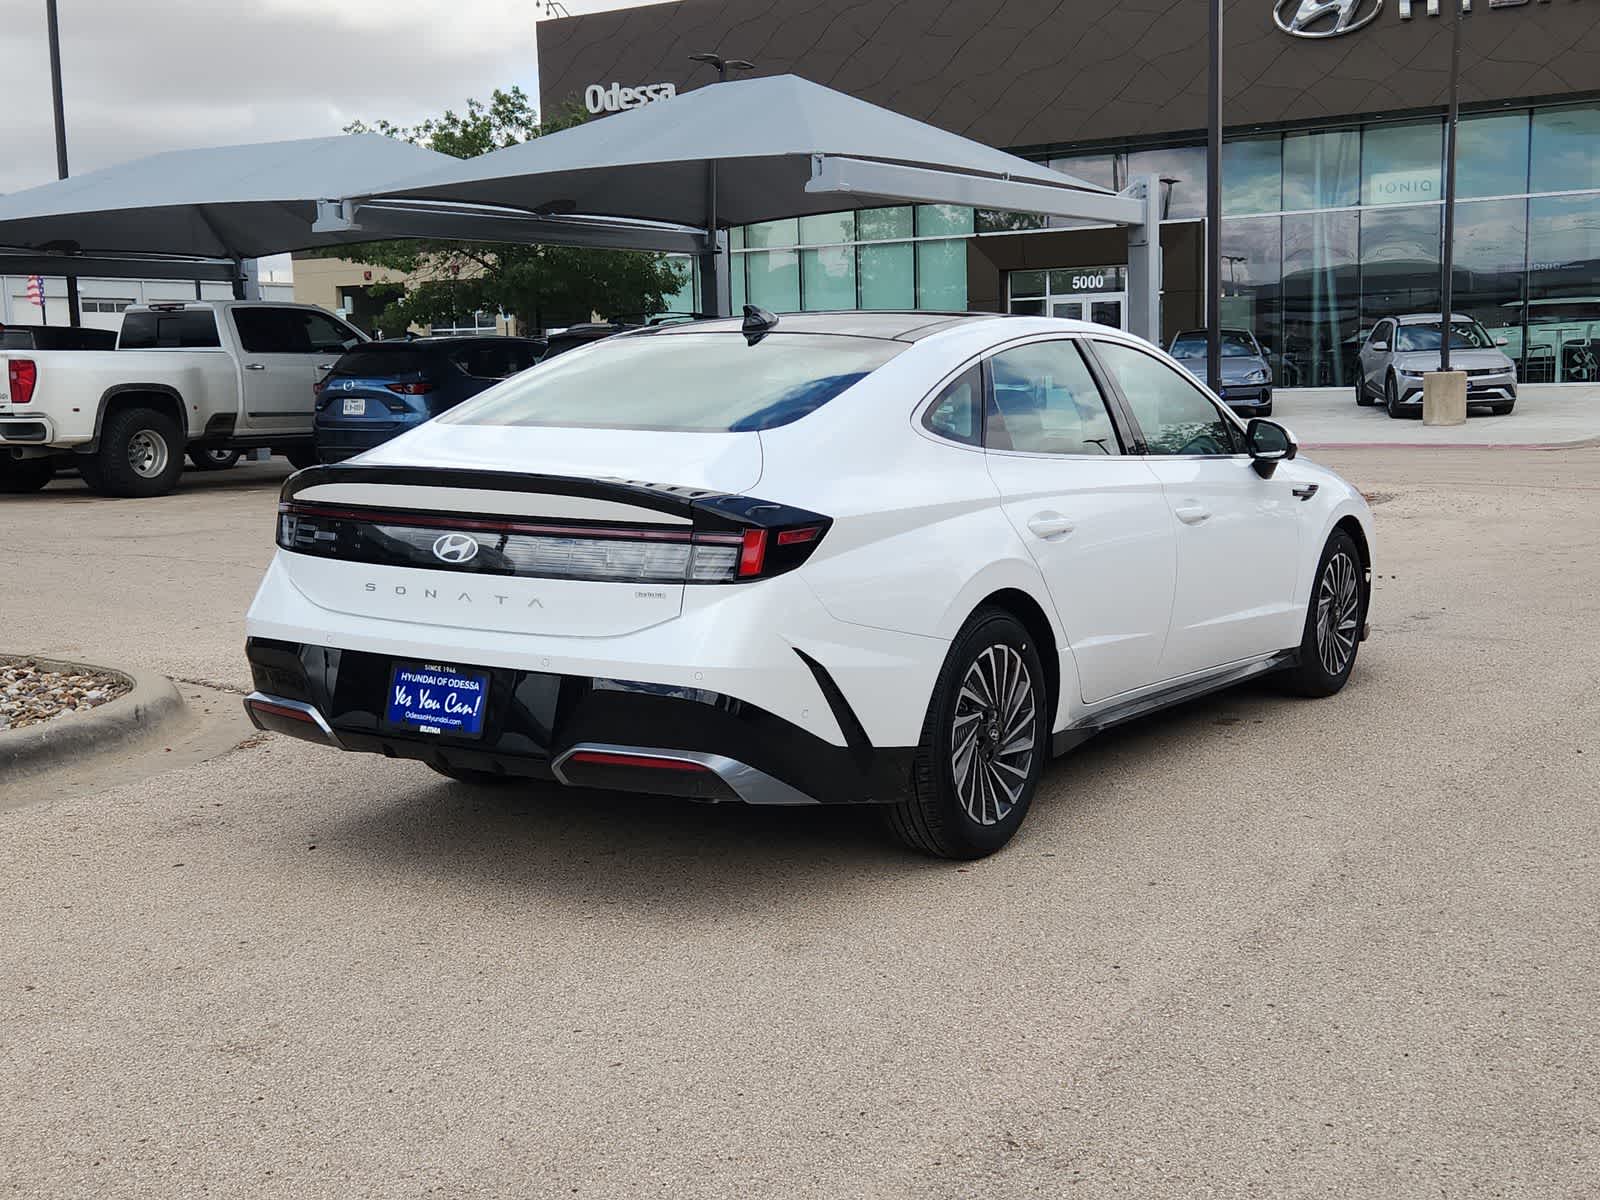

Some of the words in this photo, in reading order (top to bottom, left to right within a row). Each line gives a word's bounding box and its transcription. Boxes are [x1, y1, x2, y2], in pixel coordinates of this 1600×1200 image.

[585, 82, 676, 114] Odessa
[1071, 275, 1104, 290] 5000
[365, 582, 544, 609] SONATA
[424, 664, 442, 673] SINCE
[400, 672, 436, 686] HYUNDAI
[437, 677, 448, 686] OF
[448, 678, 480, 691] ODESSA
[394, 685, 412, 707] Yes
[418, 689, 441, 710] You
[444, 692, 482, 717] Can!
[404, 711, 462, 726] OdessaHyundai.com
